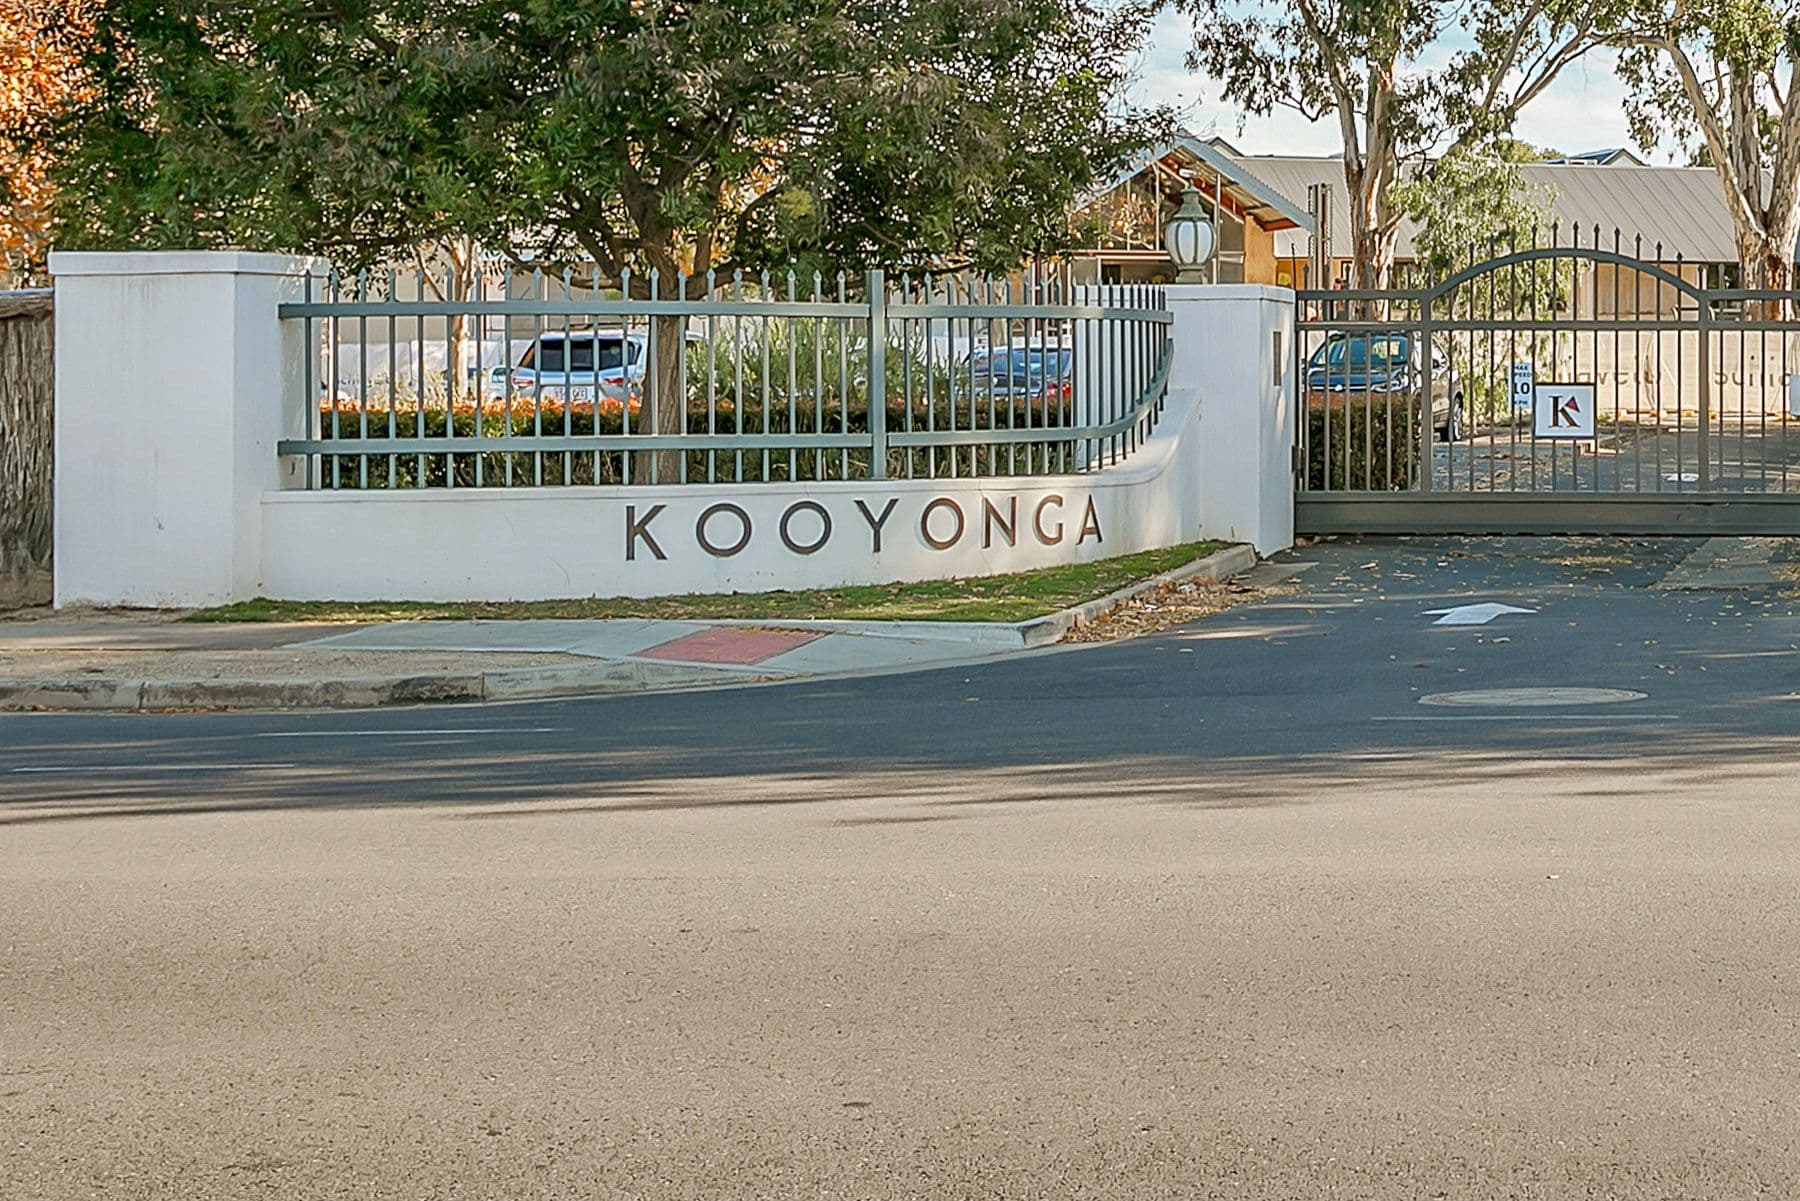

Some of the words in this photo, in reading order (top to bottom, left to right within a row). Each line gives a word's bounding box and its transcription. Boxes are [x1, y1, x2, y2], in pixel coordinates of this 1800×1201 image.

[1513, 382, 1530, 395] 10
[1548, 395, 1582, 429] K
[625, 494, 1104, 561] KOOYONGA
